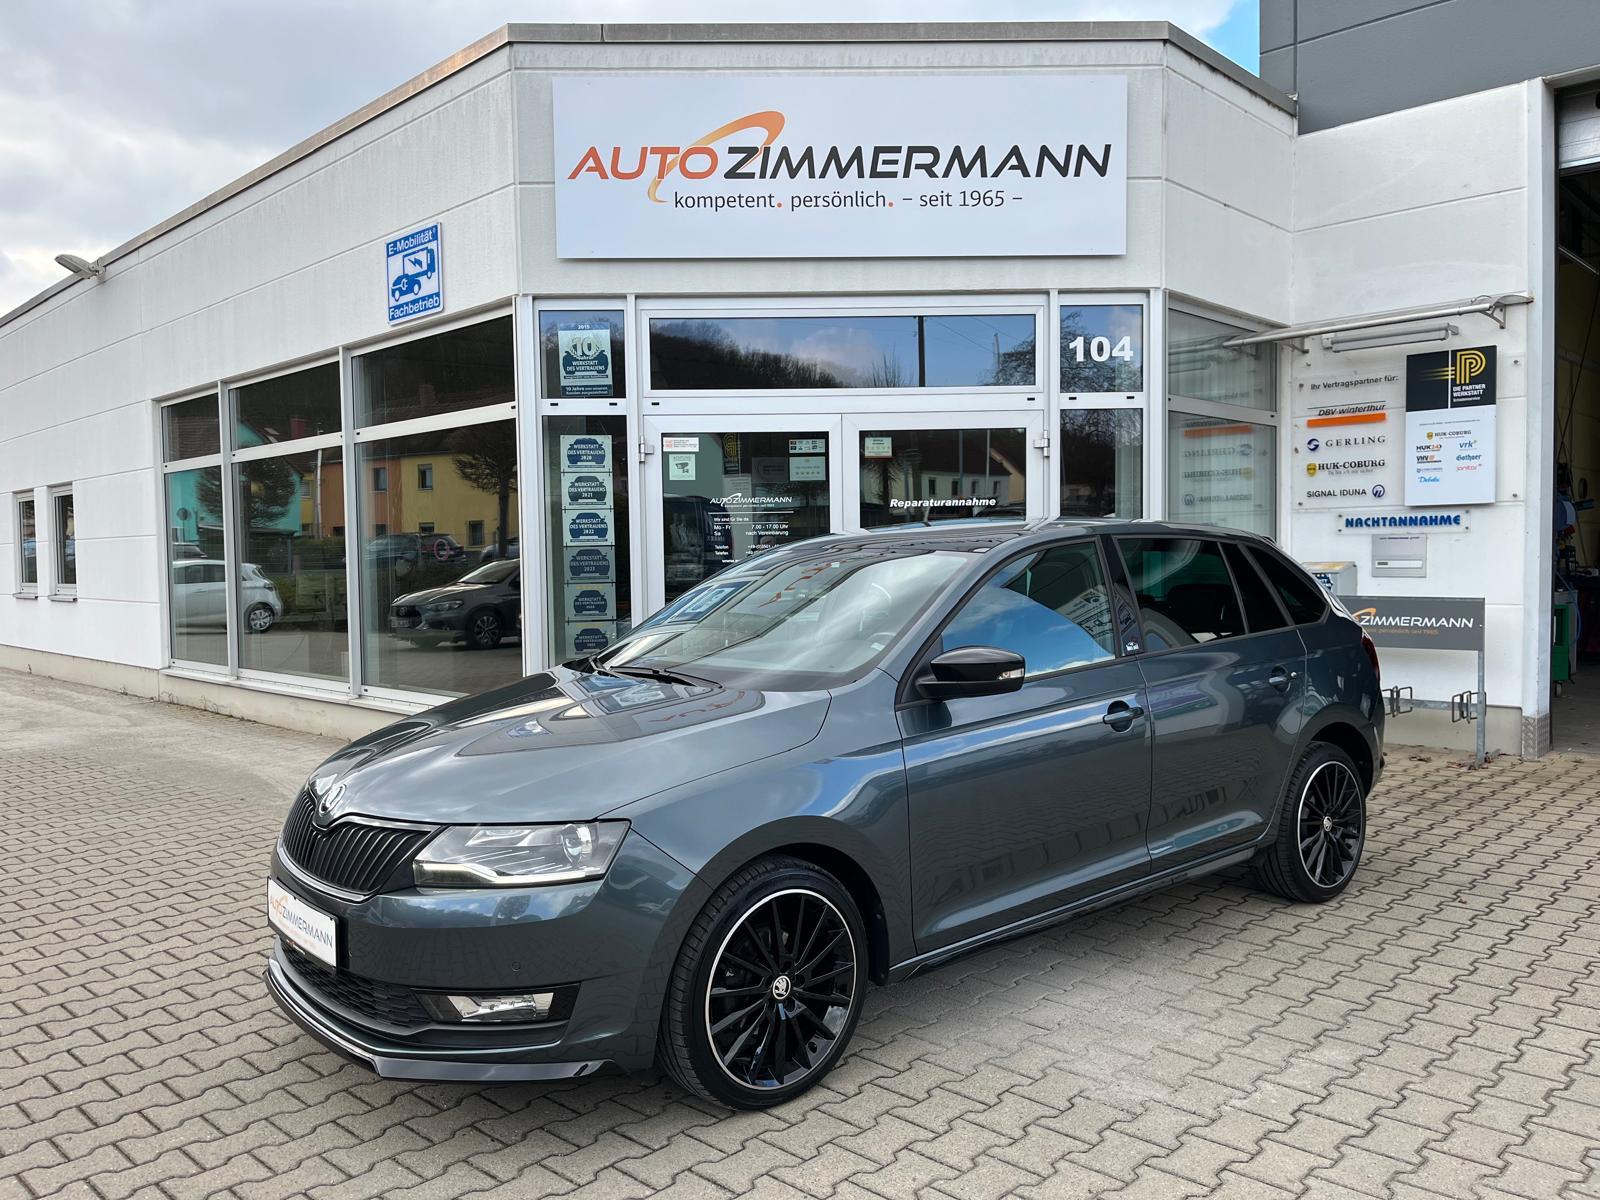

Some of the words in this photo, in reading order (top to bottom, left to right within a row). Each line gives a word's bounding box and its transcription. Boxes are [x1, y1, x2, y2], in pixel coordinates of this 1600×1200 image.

[674, 190, 783, 212] kompetent.
[790, 190, 894, 212] persönlich.
[919, 190, 952, 208] seit
[958, 190, 1005, 208] 1965
[388, 230, 433, 256] E-Mobilität
[389, 294, 440, 320] Fachbetrieb
[574, 336, 596, 356] 10
[1068, 336, 1134, 362] 104
[1322, 377, 1382, 388] Vertragspartner
[1325, 435, 1386, 448] GERLING
[1318, 459, 1385, 471] HUK-COBURG
[1306, 490, 1338, 498] SIGNAL
[889, 498, 997, 509] Reparaturannahme
[1345, 514, 1461, 528] NACHTANNAHME
[1360, 615, 1474, 628] ZIMMERMANN
